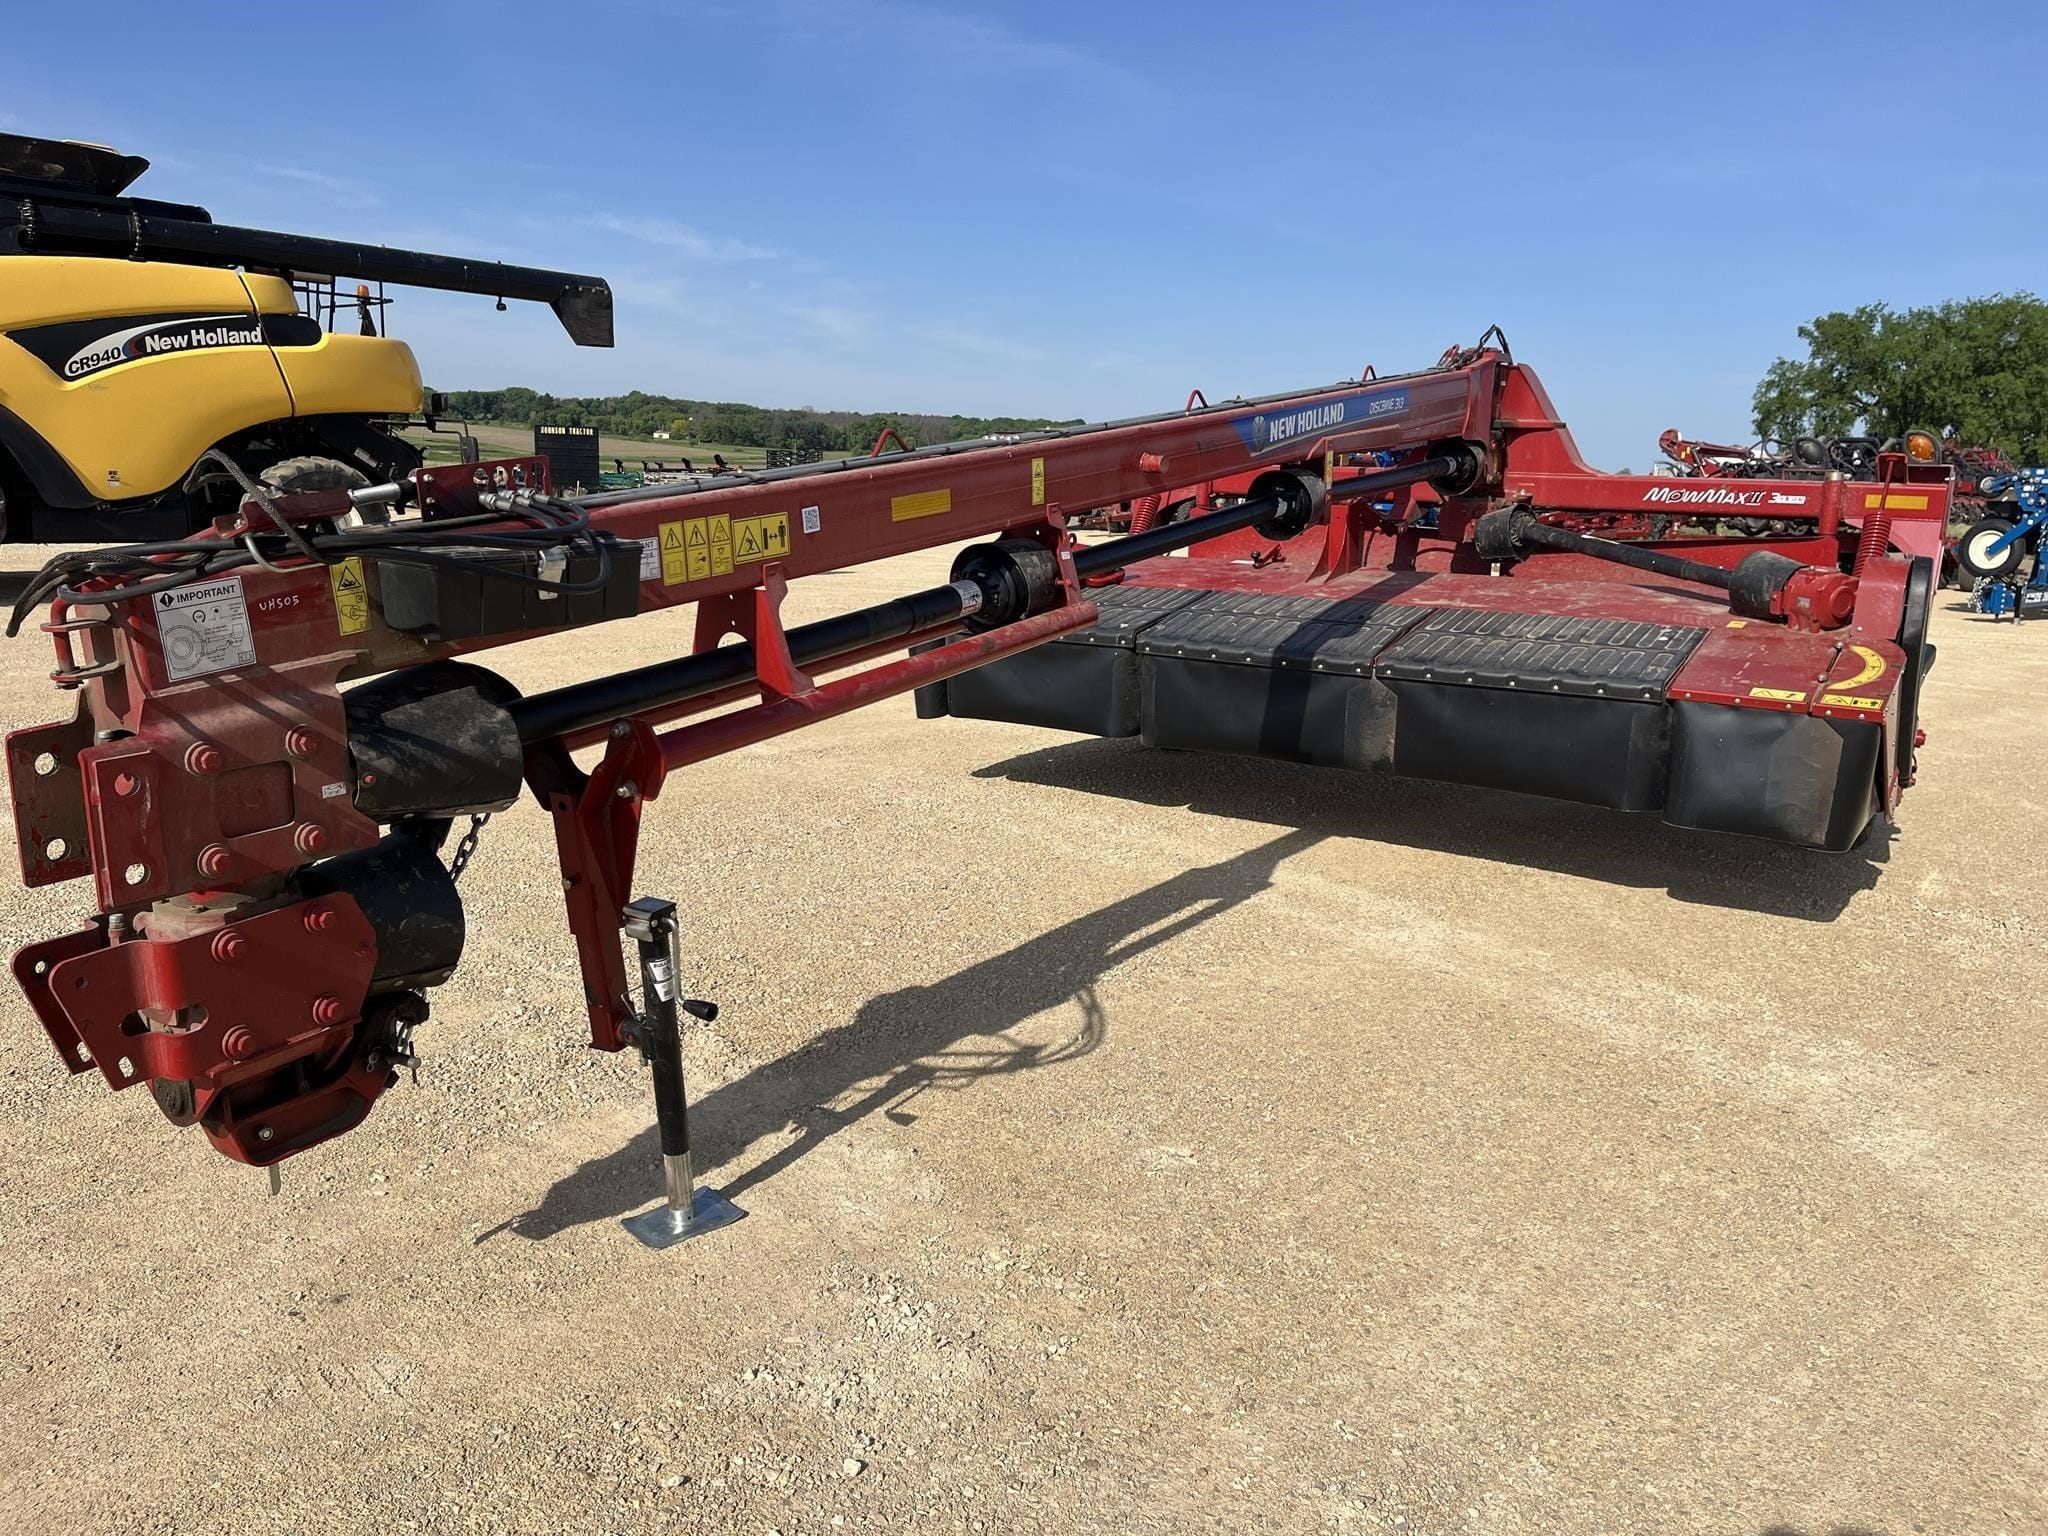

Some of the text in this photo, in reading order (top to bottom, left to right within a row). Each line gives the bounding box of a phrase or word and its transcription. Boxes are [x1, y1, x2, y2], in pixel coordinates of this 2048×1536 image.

[144, 324, 263, 353] New Holland
[68, 346, 122, 375] CR940
[569, 427, 593, 436] TRACTOR
[1269, 402, 1345, 443] NEW HOLLAND
[176, 584, 236, 603] IMPORTANT
